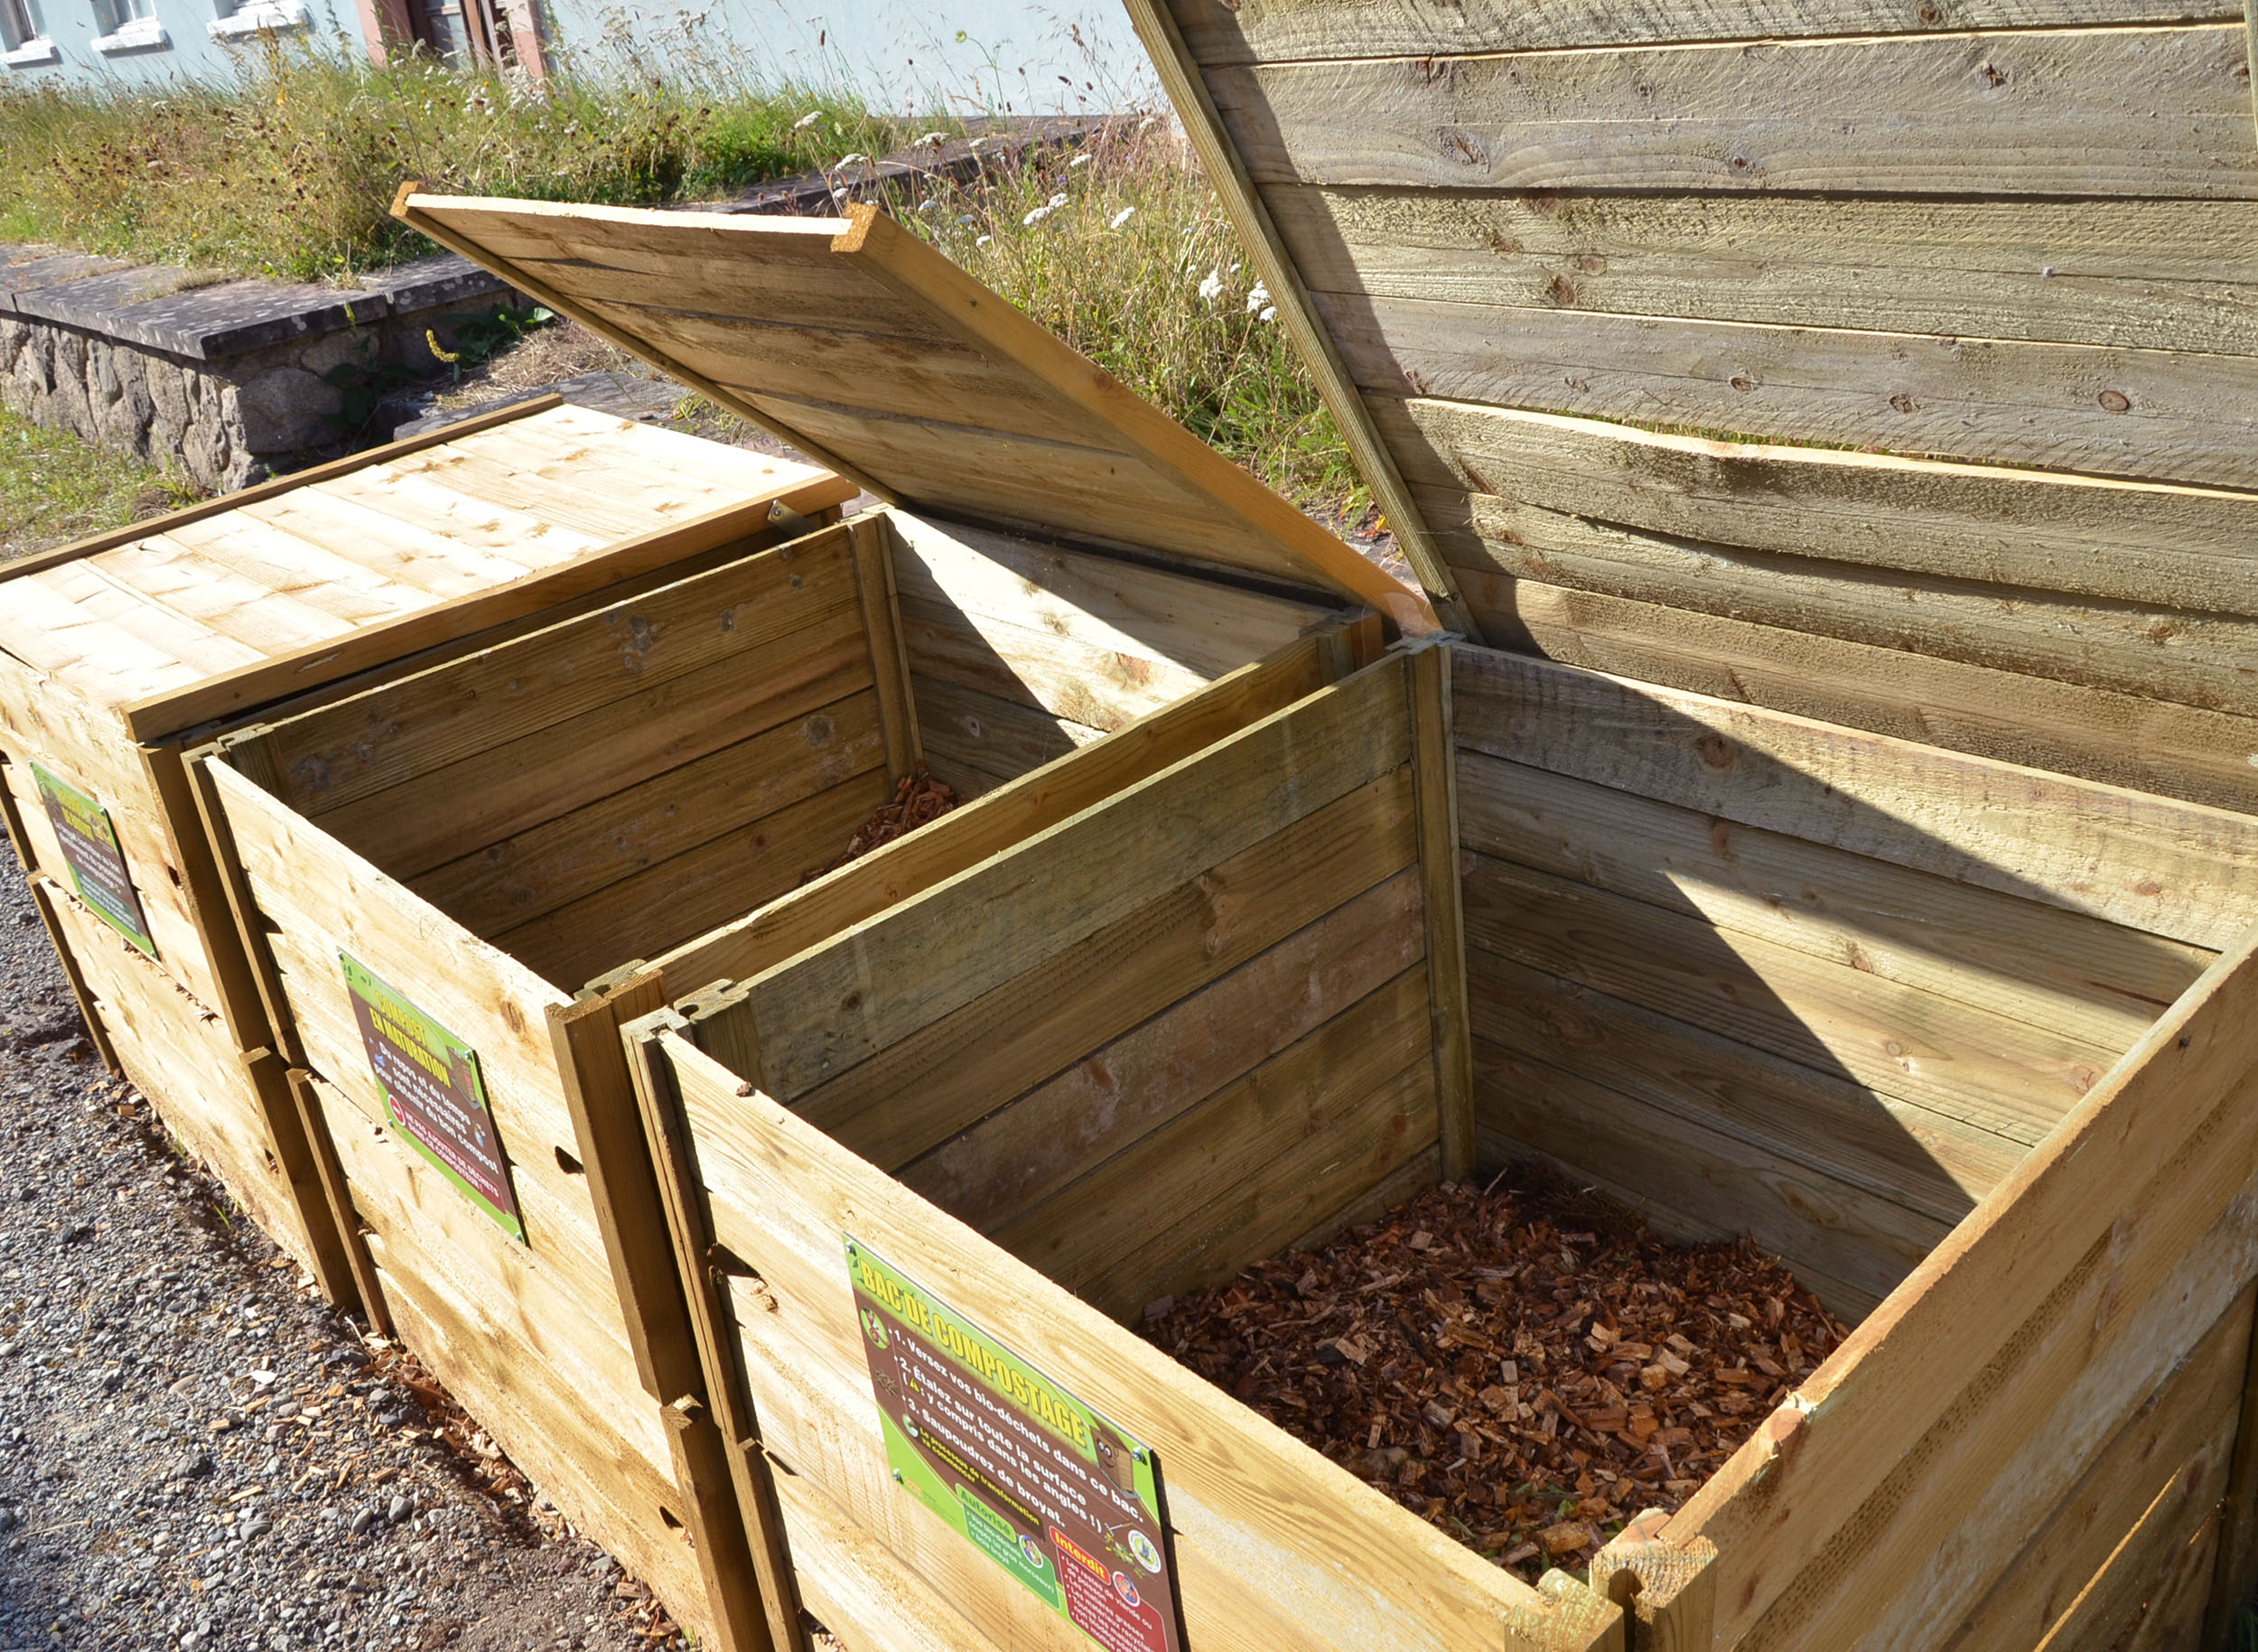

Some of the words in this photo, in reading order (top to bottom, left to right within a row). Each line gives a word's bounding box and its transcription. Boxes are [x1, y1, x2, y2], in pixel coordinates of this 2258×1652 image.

[369, 1007, 385, 1034] EN
[382, 1018, 451, 1088] MATURATION
[392, 1067, 412, 1088] sont
[378, 1041, 392, 1060] Du
[392, 1055, 417, 1080] repos
[418, 1076, 428, 1090] et
[429, 1084, 441, 1101] du
[441, 1093, 471, 1125] temps
[374, 1062, 392, 1084] pour
[394, 1079, 424, 1111] obtenir
[425, 1106, 438, 1123] du
[437, 1115, 456, 1138] bon
[457, 1134, 499, 1174] compost
[860, 1259, 903, 1312] BAC
[903, 1292, 933, 1334] DE
[933, 1312, 1086, 1446] COMPOSTAGE
[894, 1330, 906, 1346] 1.
[907, 1338, 947, 1377] Versez
[949, 1372, 972, 1395] vos
[974, 1387, 1050, 1453] bio-déchets
[1053, 1450, 1087, 1480] dans
[1090, 1478, 1107, 1496] ce
[1111, 1489, 1143, 1523] bac.
[900, 1357, 911, 1373] 2.
[913, 1366, 952, 1405] Étalez
[955, 1401, 975, 1421] sur
[977, 1416, 1012, 1451] toute
[1016, 1444, 1030, 1463] la
[1032, 1460, 1087, 1506] surface
[921, 1437, 931, 1448] va
[932, 1445, 975, 1482] commencer
[927, 1393, 934, 1405] y
[937, 1401, 984, 1442] compris
[987, 1439, 1017, 1467] dans
[1020, 1461, 1040, 1484] les
[1043, 1481, 1087, 1520] angles
[908, 1398, 919, 1414] 3.
[922, 1408, 994, 1473] Saupoudrez
[997, 1470, 1013, 1488] de
[1016, 1481, 1065, 1527] broyat.
[919, 1427, 929, 1439] Le
[930, 1437, 968, 1470] processus
[969, 1468, 979, 1479] de
[981, 1475, 1040, 1526] transformation
[960, 1489, 1011, 1535] Autorisé
[1055, 1532, 1105, 1578] Interdit
[1067, 1568, 1077, 1578] de
[1078, 1576, 1106, 1602] poisson
[1066, 1557, 1079, 1573] Les
[1080, 1571, 1103, 1591] restes
[1105, 1589, 1114, 1600] de
[1115, 1598, 1141, 1620] viande
[1142, 1619, 1152, 1629] ou
[1068, 1576, 1082, 1591] Les
[1083, 1589, 1114, 1617] matières
[1115, 1614, 1144, 1640] grasses
[1070, 1586, 1084, 1601] Les
[1085, 1599, 1120, 1629] matériaux
[1072, 1595, 1096, 1620] Toutes
[1097, 1616, 1109, 1629] les
[1074, 1605, 1087, 1619] non
[1076, 1614, 1089, 1629] Les
